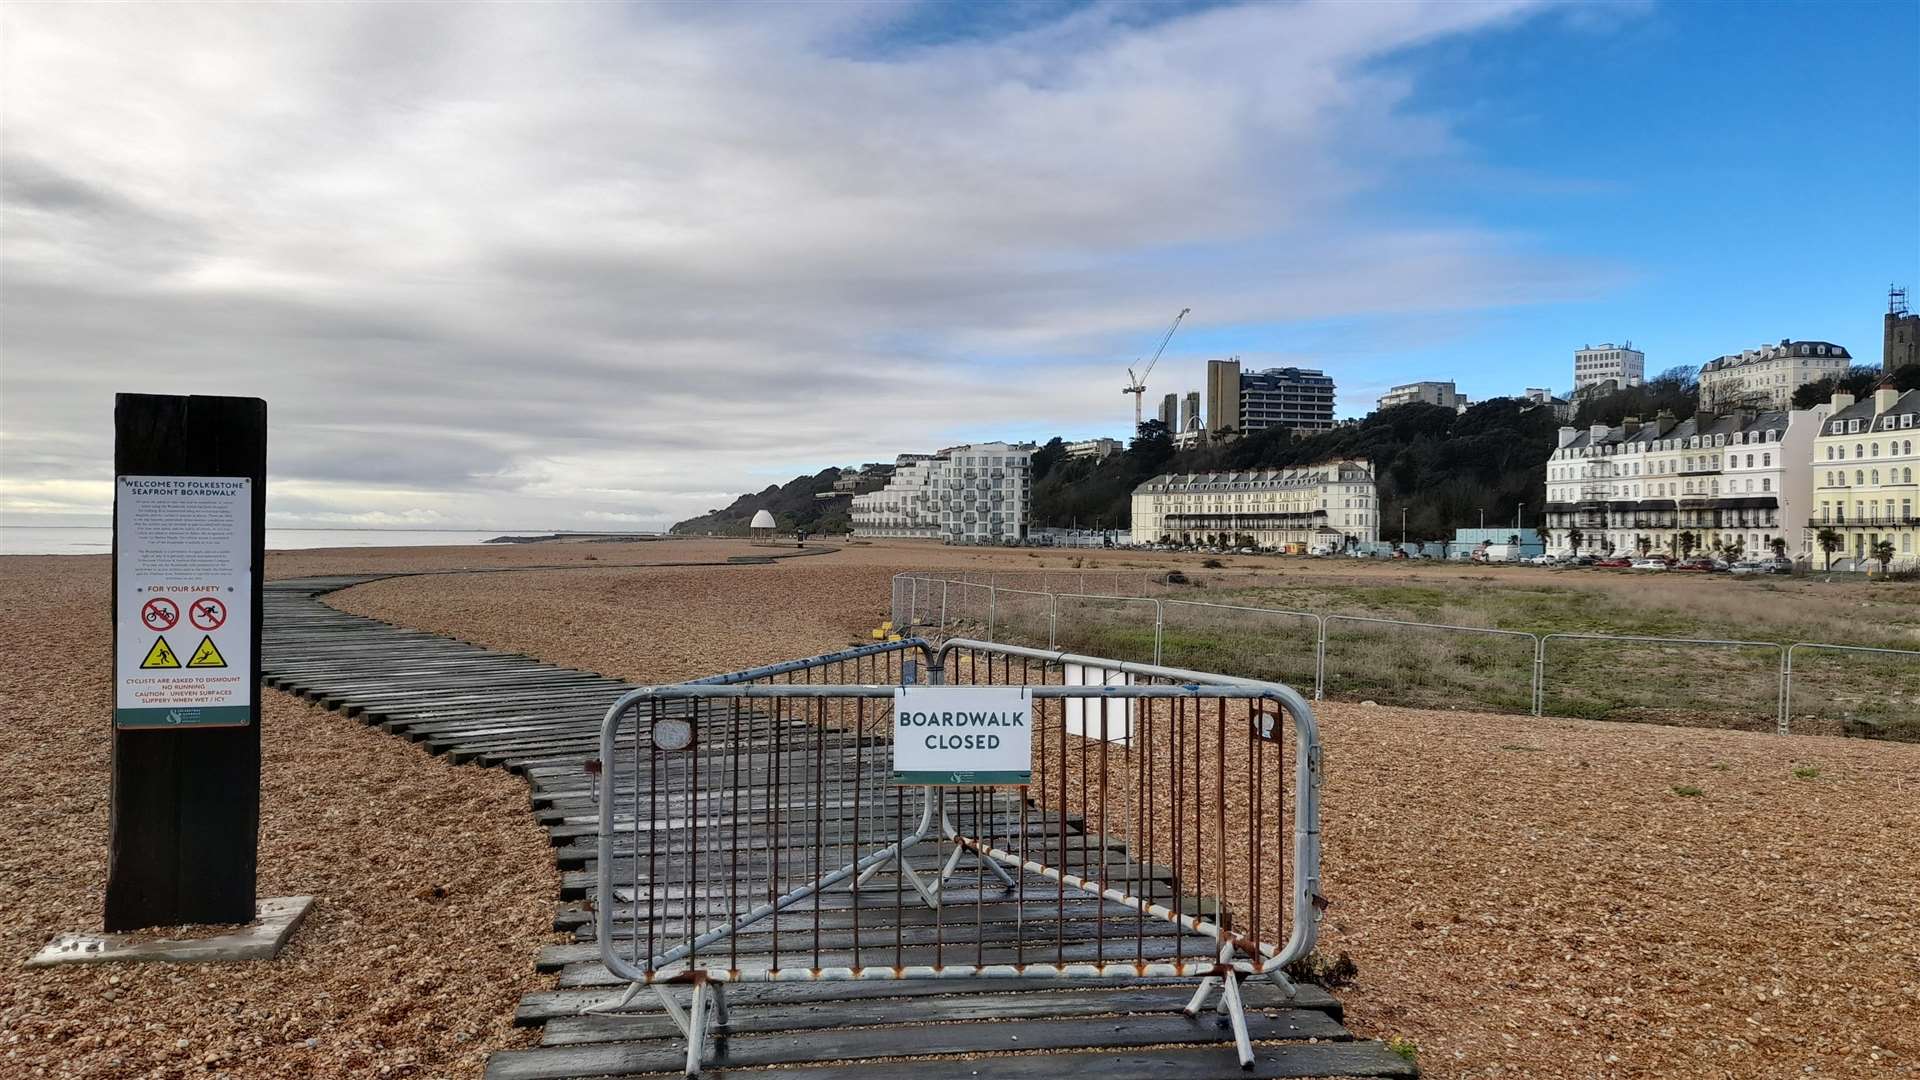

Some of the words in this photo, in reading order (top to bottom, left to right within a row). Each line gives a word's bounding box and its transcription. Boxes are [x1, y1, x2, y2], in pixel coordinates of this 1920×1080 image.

[187, 481, 244, 489] FOLKESTONE
[899, 711, 1025, 727] BOARDWALK
[925, 734, 1000, 750] CLOSED
